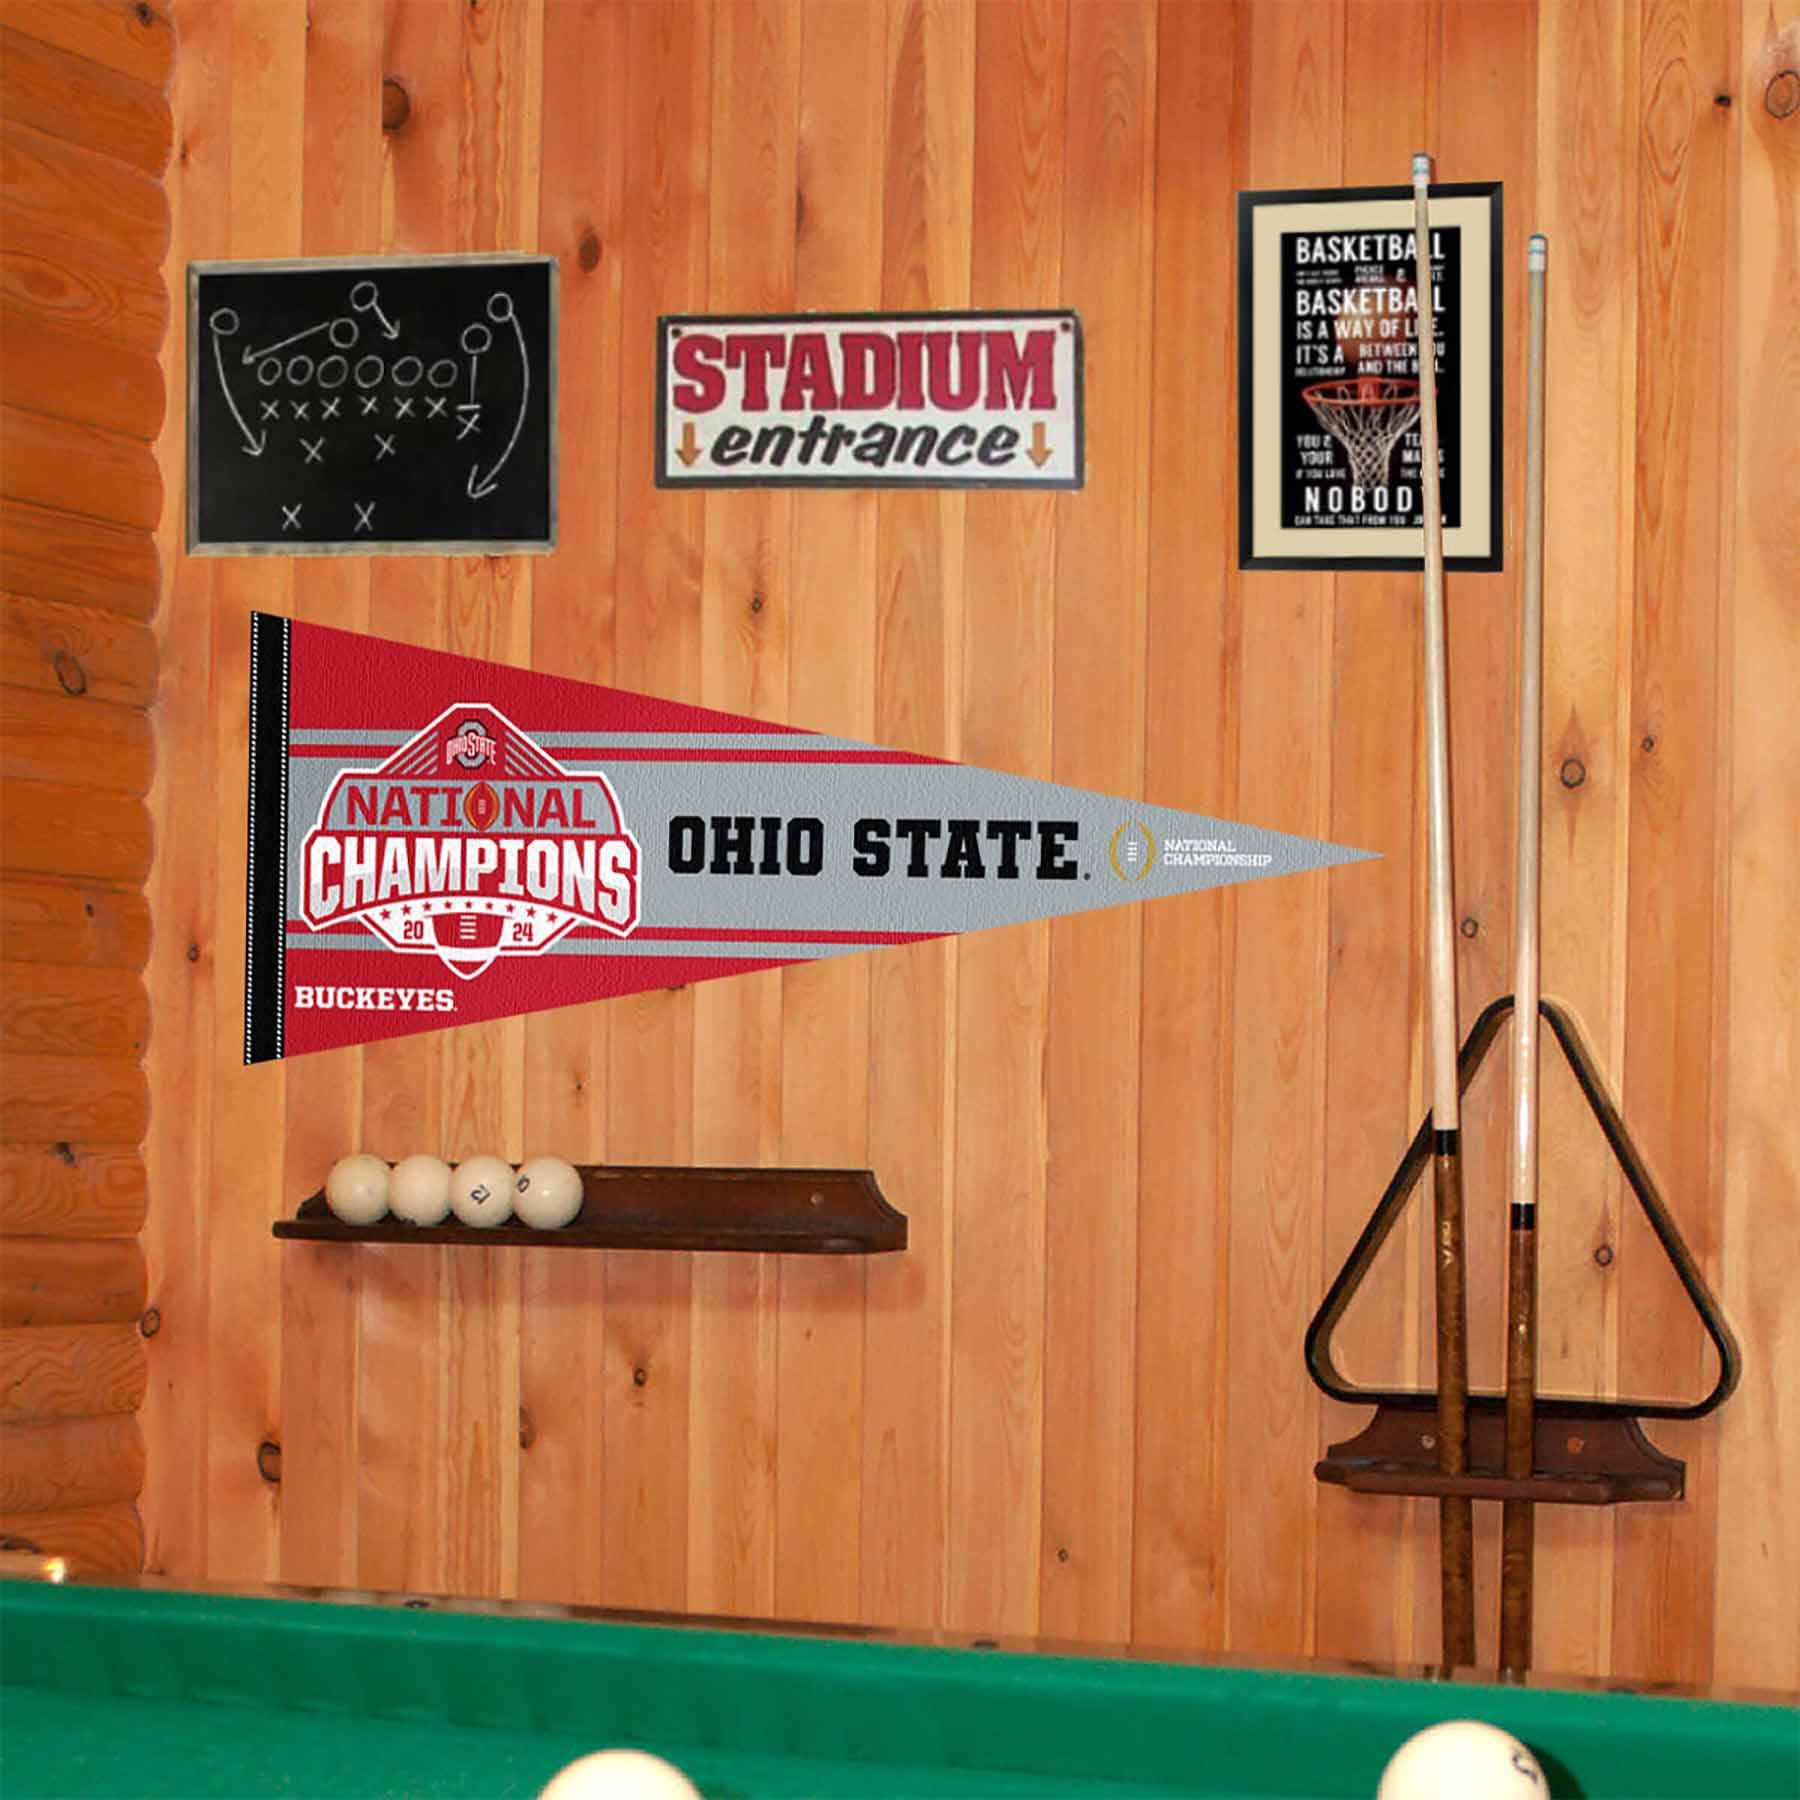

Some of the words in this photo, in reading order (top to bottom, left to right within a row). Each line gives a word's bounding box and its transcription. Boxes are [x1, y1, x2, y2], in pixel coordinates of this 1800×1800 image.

[1295, 232, 1445, 264] BASKETBAL
[1295, 286, 1445, 316] BASKETBAL
[1296, 320, 1313, 340] IS
[1317, 320, 1329, 340] A
[1334, 319, 1375, 339] WAY
[1379, 319, 1399, 338] OF
[1296, 345, 1328, 365] IT'S
[1333, 345, 1344, 364] A
[672, 330, 1057, 413] STADIUM
[711, 415, 1020, 467] entrance
[1304, 486, 1414, 514] NOBOD
[346, 783, 596, 830] NATIONAL
[668, 816, 824, 876] OHIO
[853, 818, 1079, 880] STATE
[1164, 839, 1236, 852] NATIONAL
[1164, 853, 1272, 867] CHAMPIONSHIP
[308, 836, 638, 926] CHAMPIONS
[403, 921, 424, 940] 20
[512, 922, 533, 941] 24
[295, 986, 454, 1012] BUCKEYES
